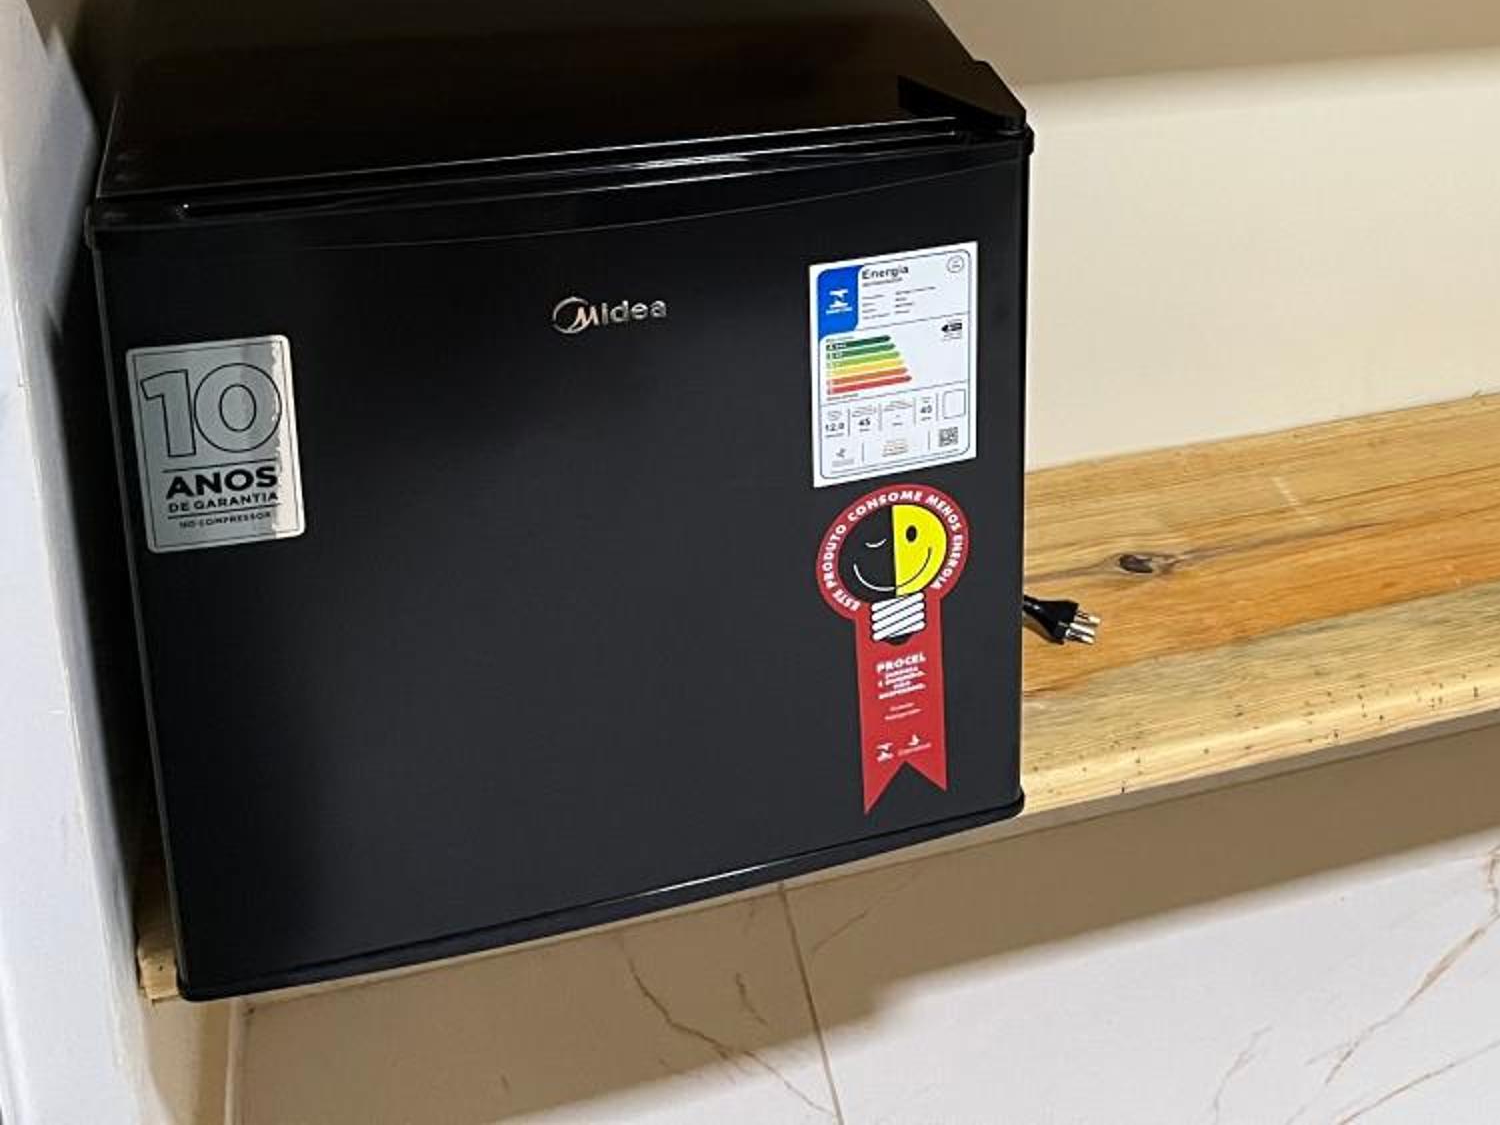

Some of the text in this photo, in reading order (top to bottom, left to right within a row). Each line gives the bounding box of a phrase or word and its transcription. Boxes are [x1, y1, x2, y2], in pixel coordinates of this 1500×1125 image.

[861, 266, 909, 279] Energia
[553, 296, 667, 334] Midea
[140, 362, 283, 458] 10
[165, 466, 278, 500] ANOS
[168, 492, 278, 513] DE GARANTIA
[847, 490, 923, 522] CONSOME
[925, 493, 963, 532] MENOS
[821, 524, 848, 589] PRODUTO
[832, 588, 862, 612] ESTE
[876, 651, 927, 674] PROCEL
